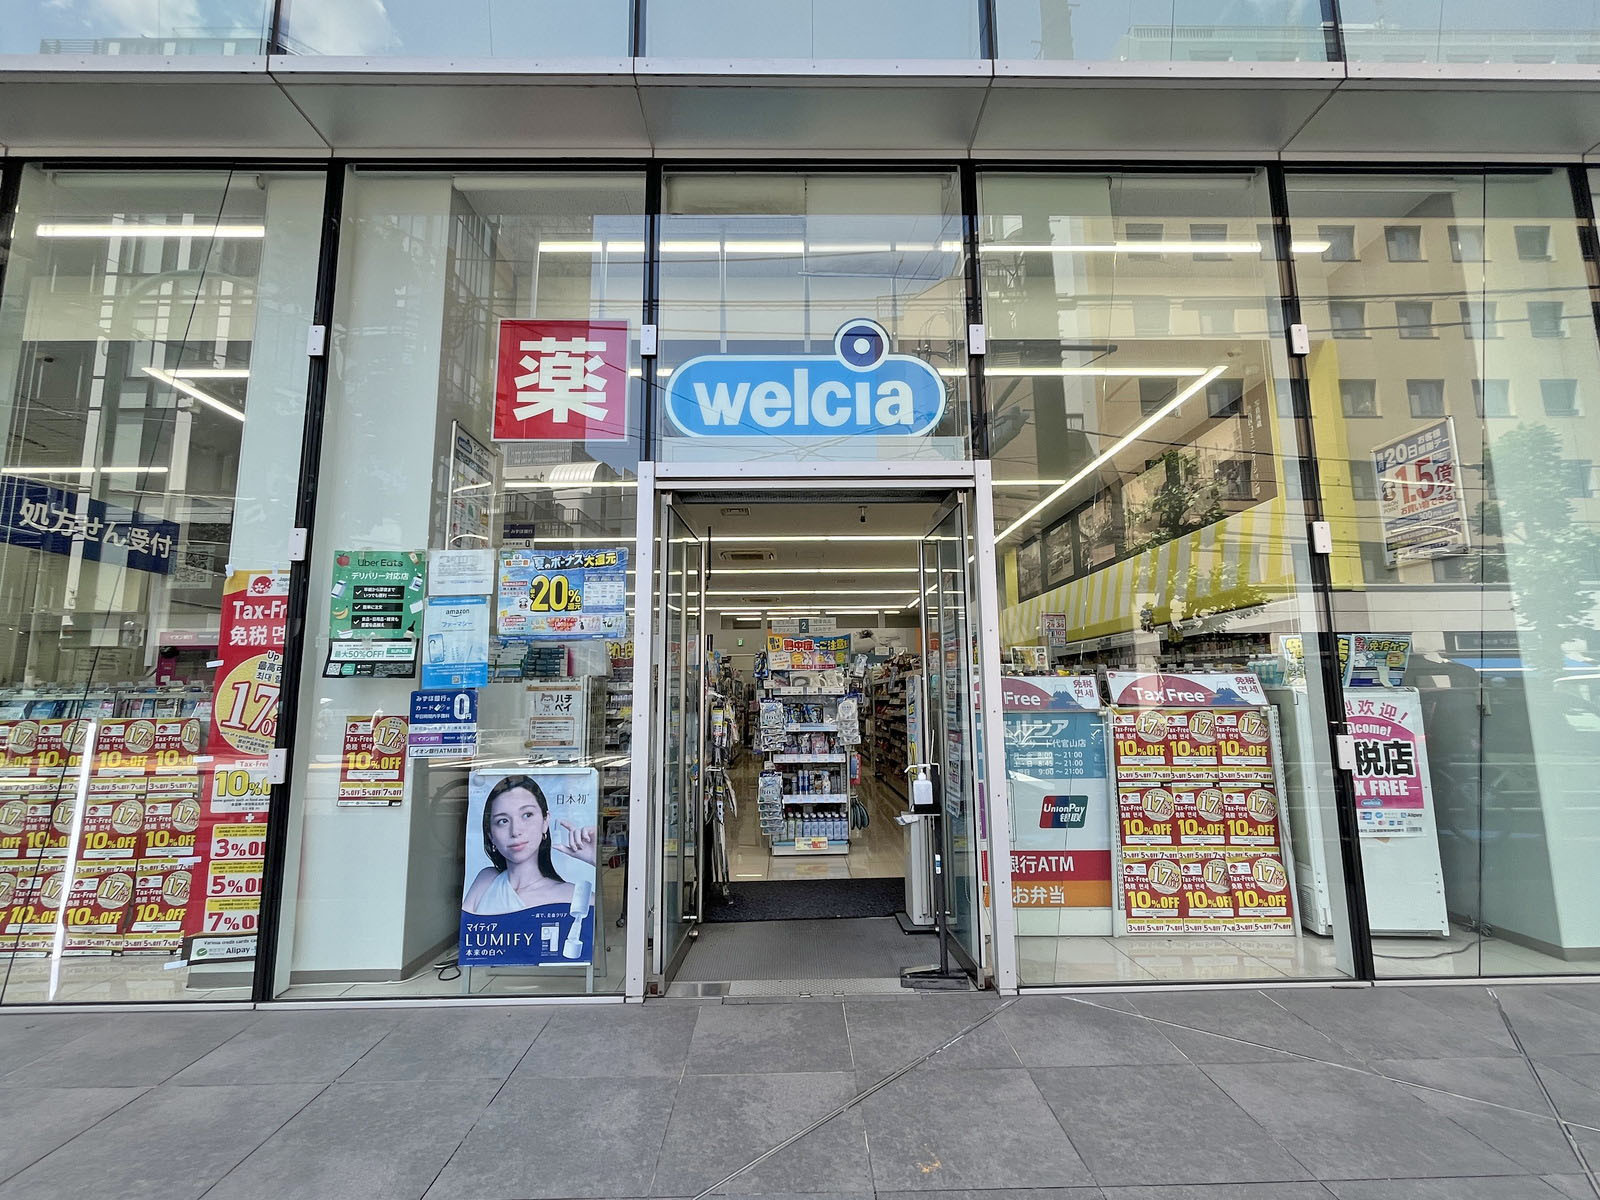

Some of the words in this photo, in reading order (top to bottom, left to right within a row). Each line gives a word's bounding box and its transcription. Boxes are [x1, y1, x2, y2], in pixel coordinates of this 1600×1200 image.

[513, 337, 608, 423] 薬
[693, 368, 915, 426] welcia
[20, 498, 172, 558] 処方せん受付
[357, 559, 379, 567] Uber
[381, 559, 403, 567] Eats
[233, 601, 287, 620] Tax-Fr
[801, 621, 807, 630] 2
[1003, 691, 1040, 706] Free
[1131, 687, 1165, 704] Tax
[1167, 688, 1205, 703] Free
[1347, 722, 1392, 737] elcome!
[1064, 752, 1083, 760] 21:00
[1117, 740, 1165, 756] 10%OFF
[1169, 740, 1217, 756] 10%OFF
[1218, 740, 1268, 757] 10%OFF
[346, 752, 402, 770] 10%OFF
[1354, 741, 1414, 776] 税店
[1065, 768, 1084, 776] 21:00
[1370, 780, 1409, 797] FREE
[556, 793, 588, 805] 日本初
[1043, 803, 1085, 815] UnionPay
[1122, 819, 1171, 835] 10%OFF
[1177, 819, 1224, 835] 10%OFF
[1227, 819, 1274, 836] 10%OFF
[85, 832, 137, 849] 10%OFF
[145, 831, 196, 848] 10%OFF
[1012, 885, 1065, 904] お弁当
[1128, 891, 1179, 908] 10%OFF
[1186, 891, 1232, 908] 10%OFF
[1235, 890, 1287, 907] 10%OFF
[66, 907, 122, 925] 10%OFF
[136, 904, 186, 922] 10%OFF
[467, 923, 498, 932] マイティア
[465, 933, 534, 948] LUMIFY
[226, 946, 250, 955] Alipay
